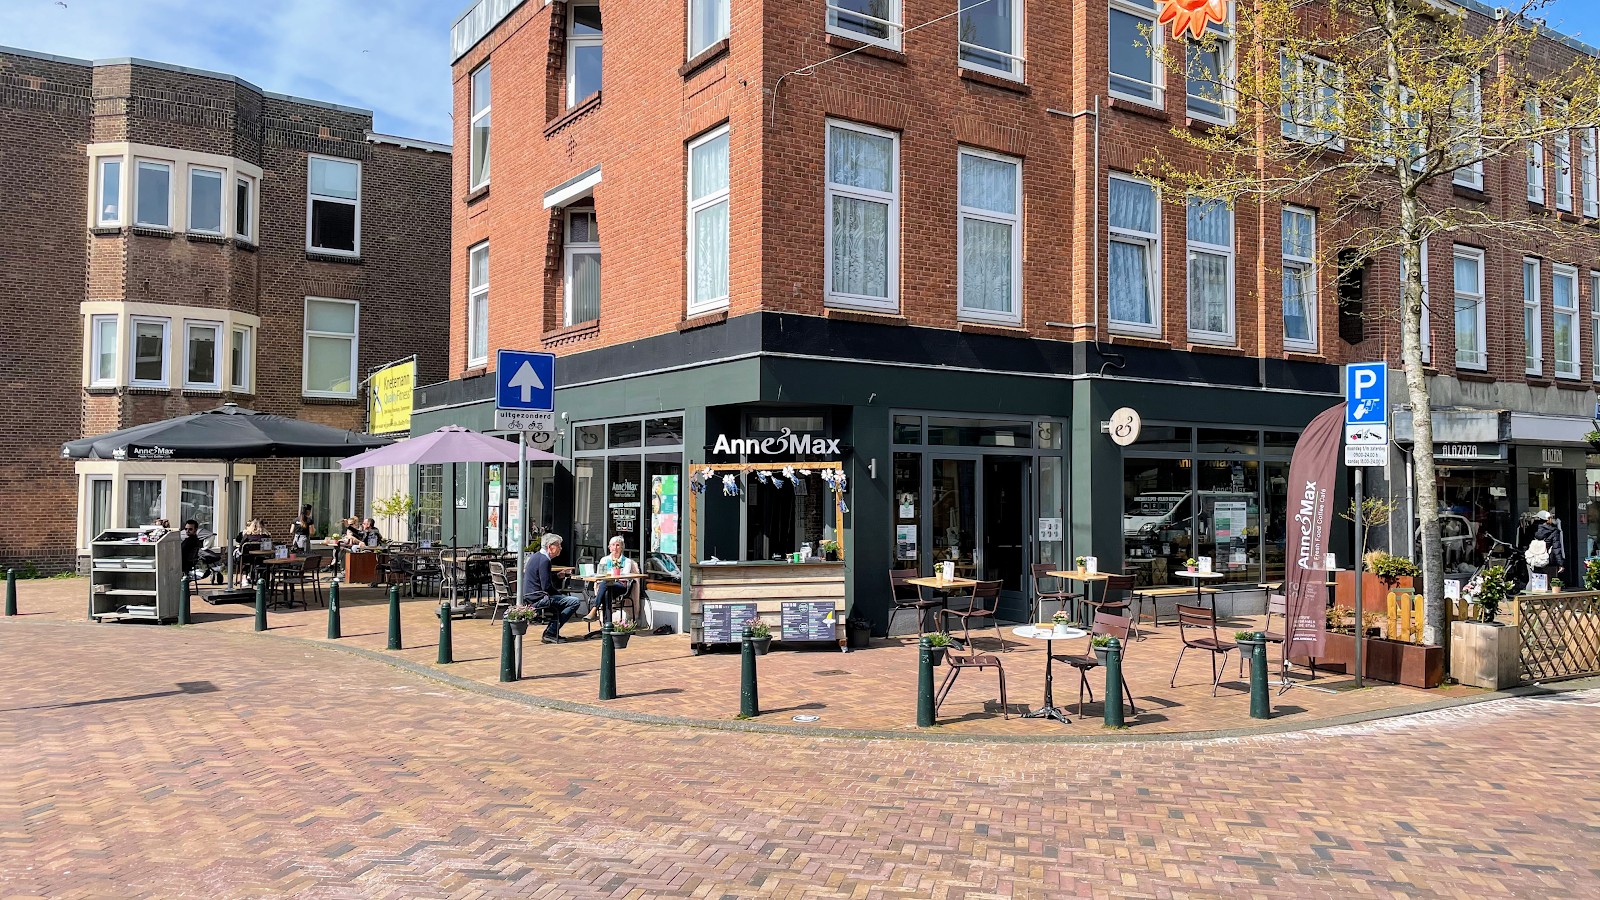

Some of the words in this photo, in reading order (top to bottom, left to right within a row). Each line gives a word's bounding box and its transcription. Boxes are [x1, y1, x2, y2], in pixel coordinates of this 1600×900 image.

[1355, 369, 1377, 399] P
[500, 411, 551, 419] uitgezonderd
[712, 427, 841, 455] Anne&Max
[1442, 444, 1478, 457] ALAZAZA
[1542, 448, 1563, 463] ALAZAZA
[1295, 480, 1317, 569] Anne&Max
